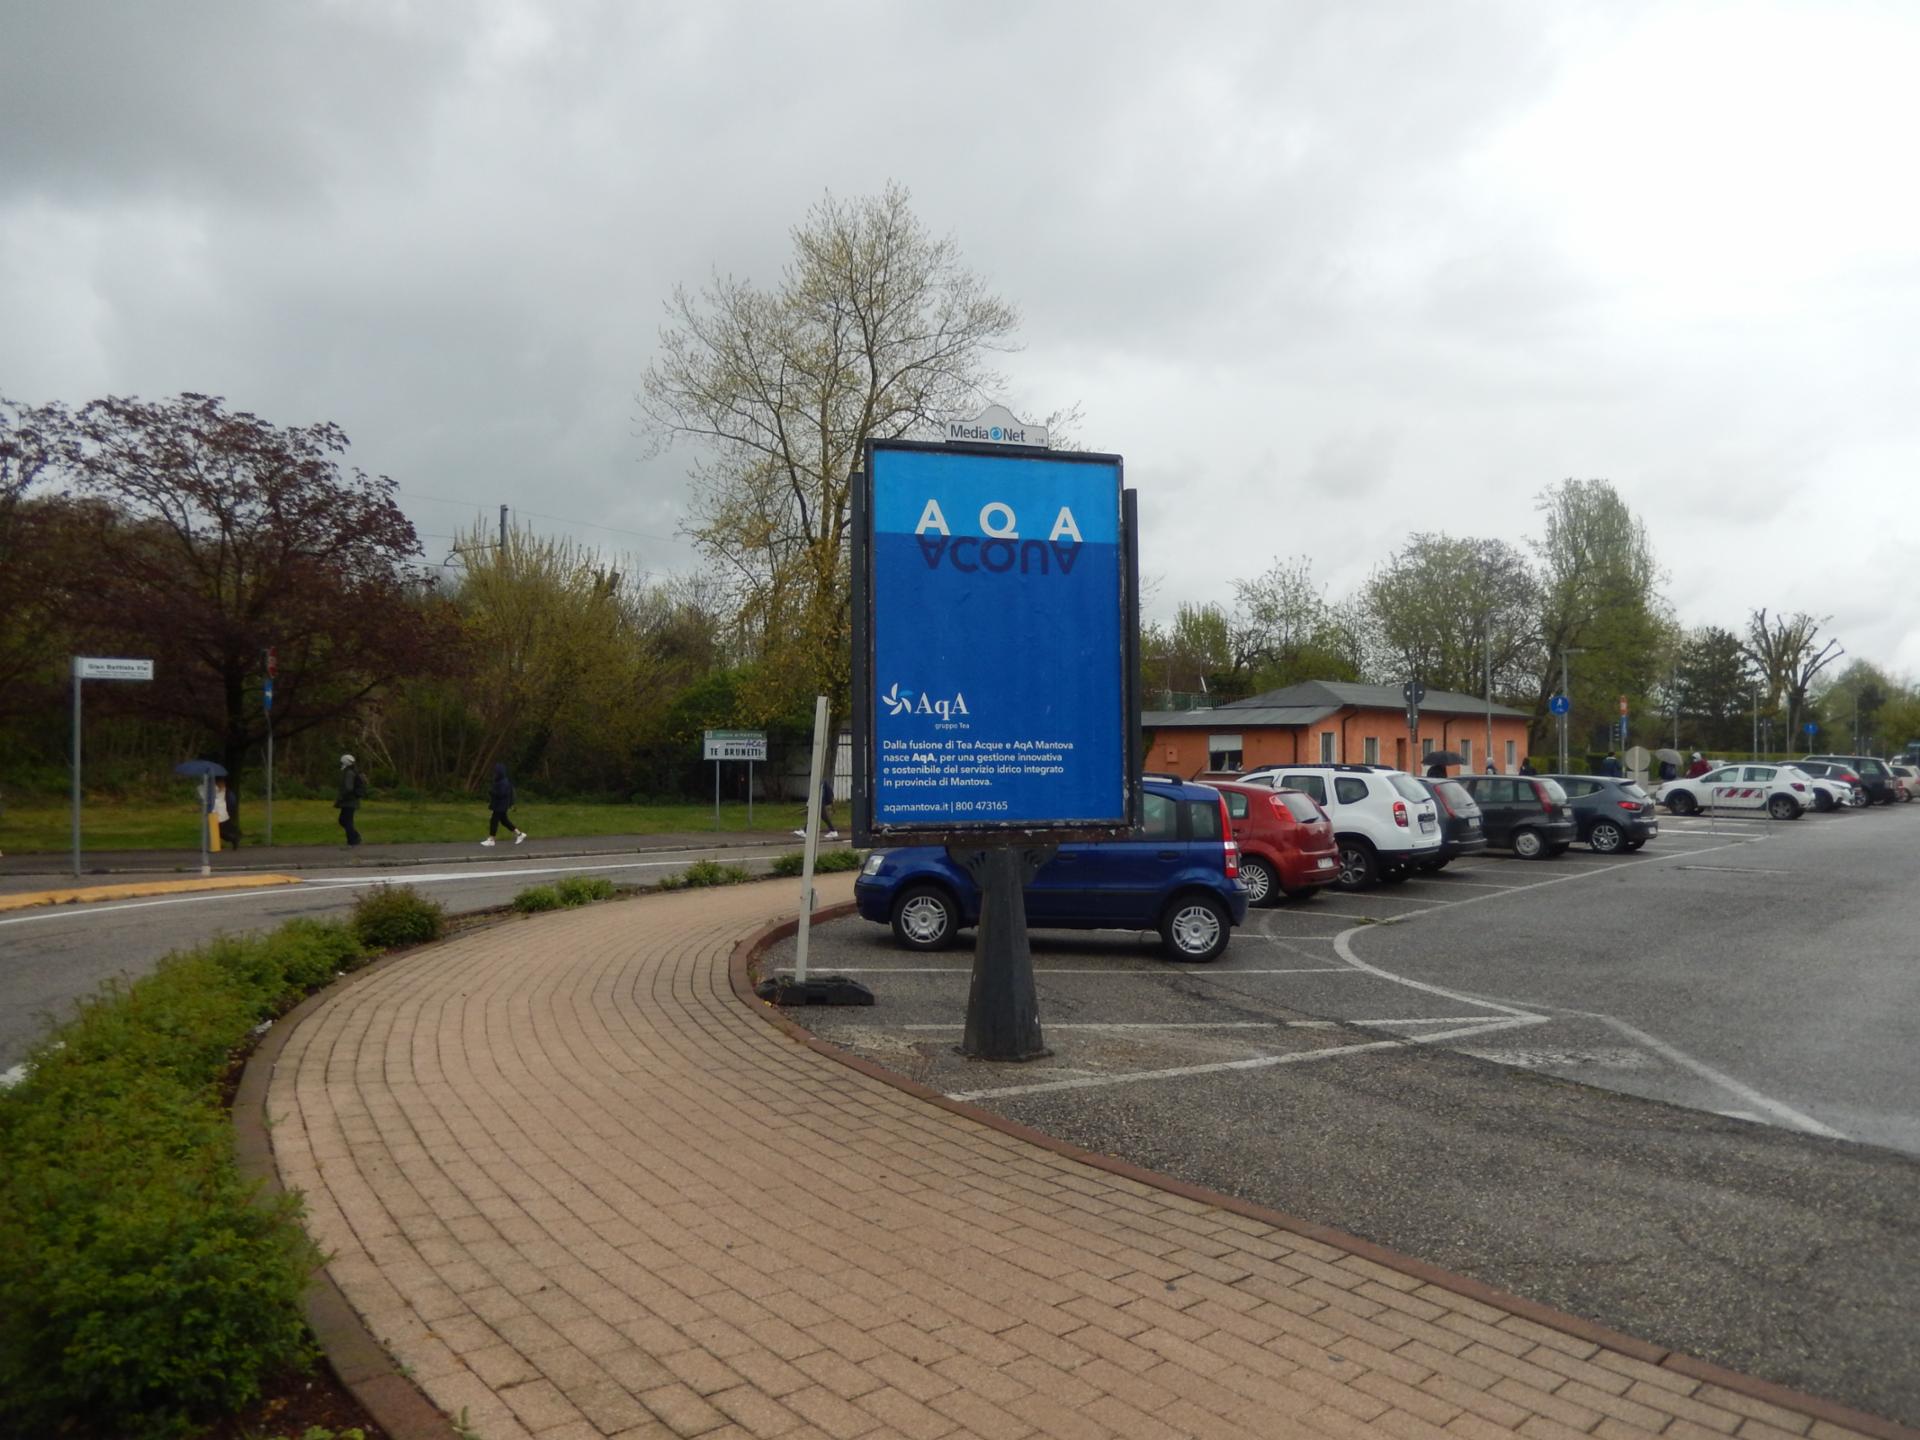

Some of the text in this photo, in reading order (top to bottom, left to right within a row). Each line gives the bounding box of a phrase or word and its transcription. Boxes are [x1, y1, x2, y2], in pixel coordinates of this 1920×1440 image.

[950, 424, 1026, 442] Media Net
[913, 692, 970, 721] AqA
[959, 722, 970, 730] Tea
[883, 740, 907, 750] Dalla
[909, 740, 943, 750] fusione
[945, 740, 955, 750] di
[957, 740, 972, 750] Tea
[975, 740, 1003, 751] Acque
[1013, 740, 1033, 751] AqA
[1035, 740, 1074, 750] Mantova
[724, 747, 761, 757] BRUNETTI
[912, 753, 937, 764] AqA,
[940, 755, 956, 764] per
[977, 753, 1015, 764] gestione
[1018, 753, 1063, 762] innovativa
[892, 764, 941, 774] sostenibile
[943, 764, 958, 774] del
[960, 765, 994, 774] servizio
[997, 764, 1022, 774] idrico
[1024, 764, 1064, 775] integrato
[883, 776, 993, 788] in provincia di Mantova.
[883, 800, 1008, 813] aqamantova.it 800 473165
